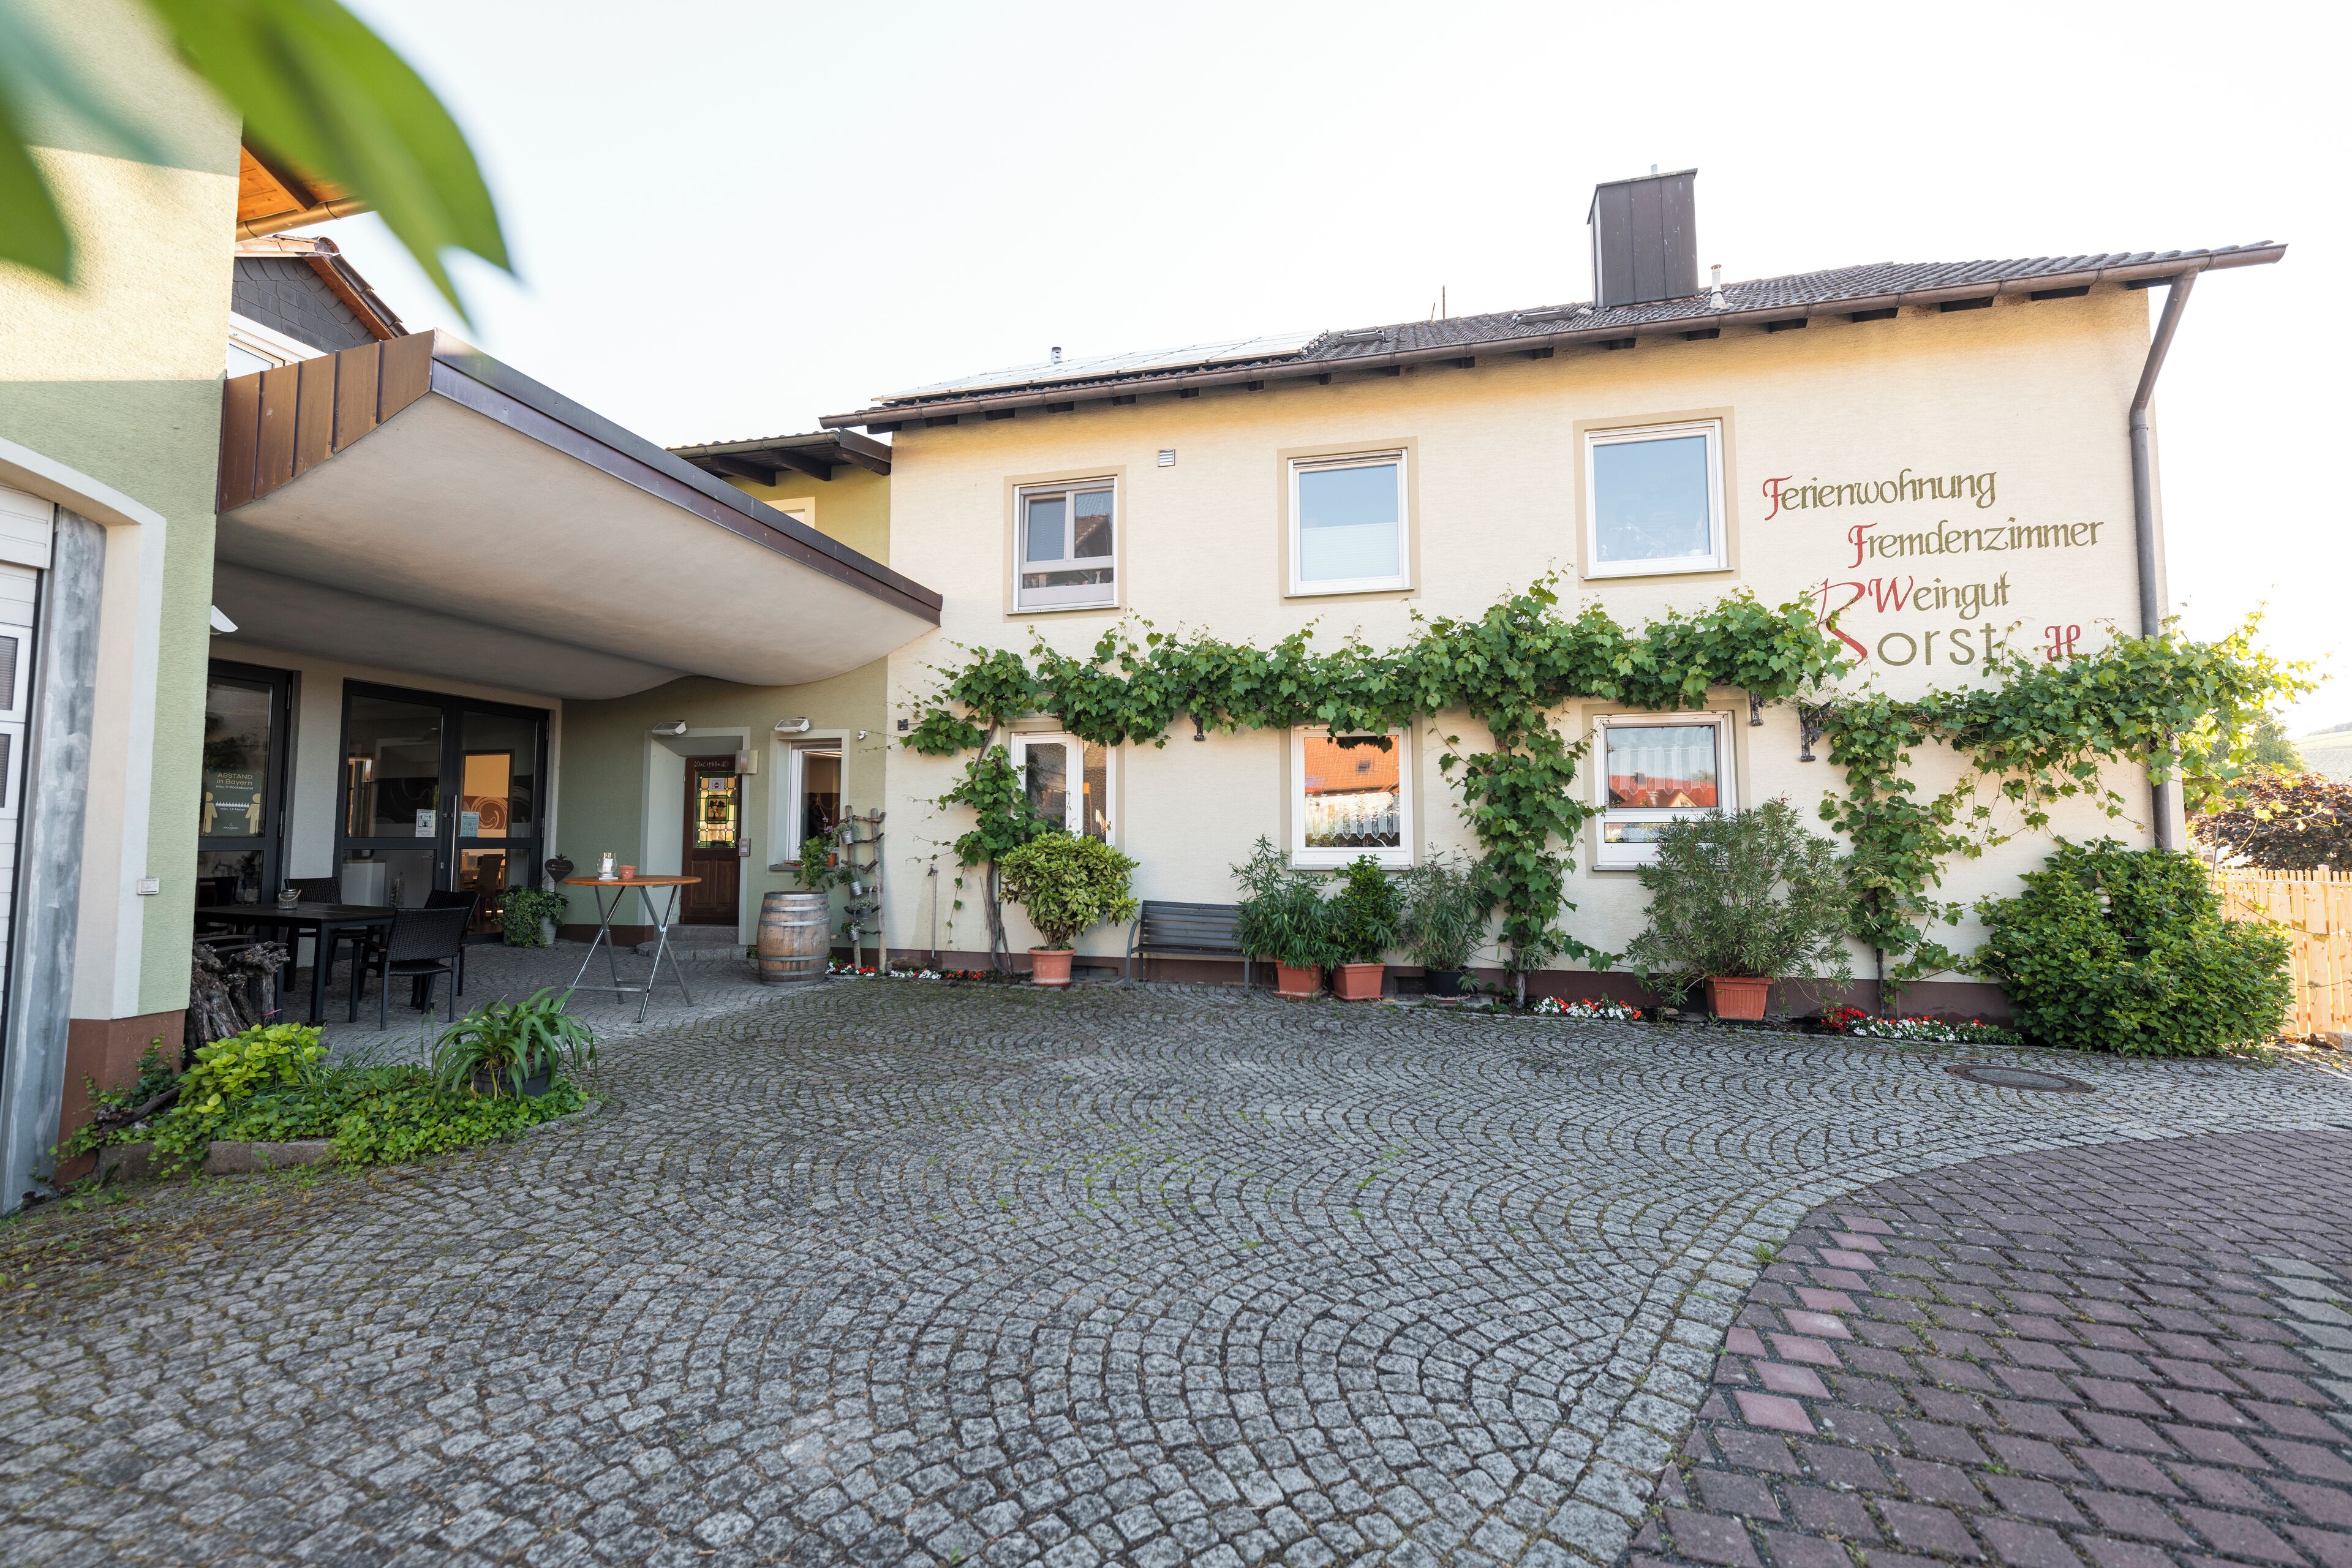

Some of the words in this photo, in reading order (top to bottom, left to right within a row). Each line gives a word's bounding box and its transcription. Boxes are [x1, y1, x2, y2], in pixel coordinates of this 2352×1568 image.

[1762, 468, 1997, 521] Ferienwohnung
[1847, 516, 2105, 569] Fremdenzimmer
[1868, 571, 2011, 620] Weingut
